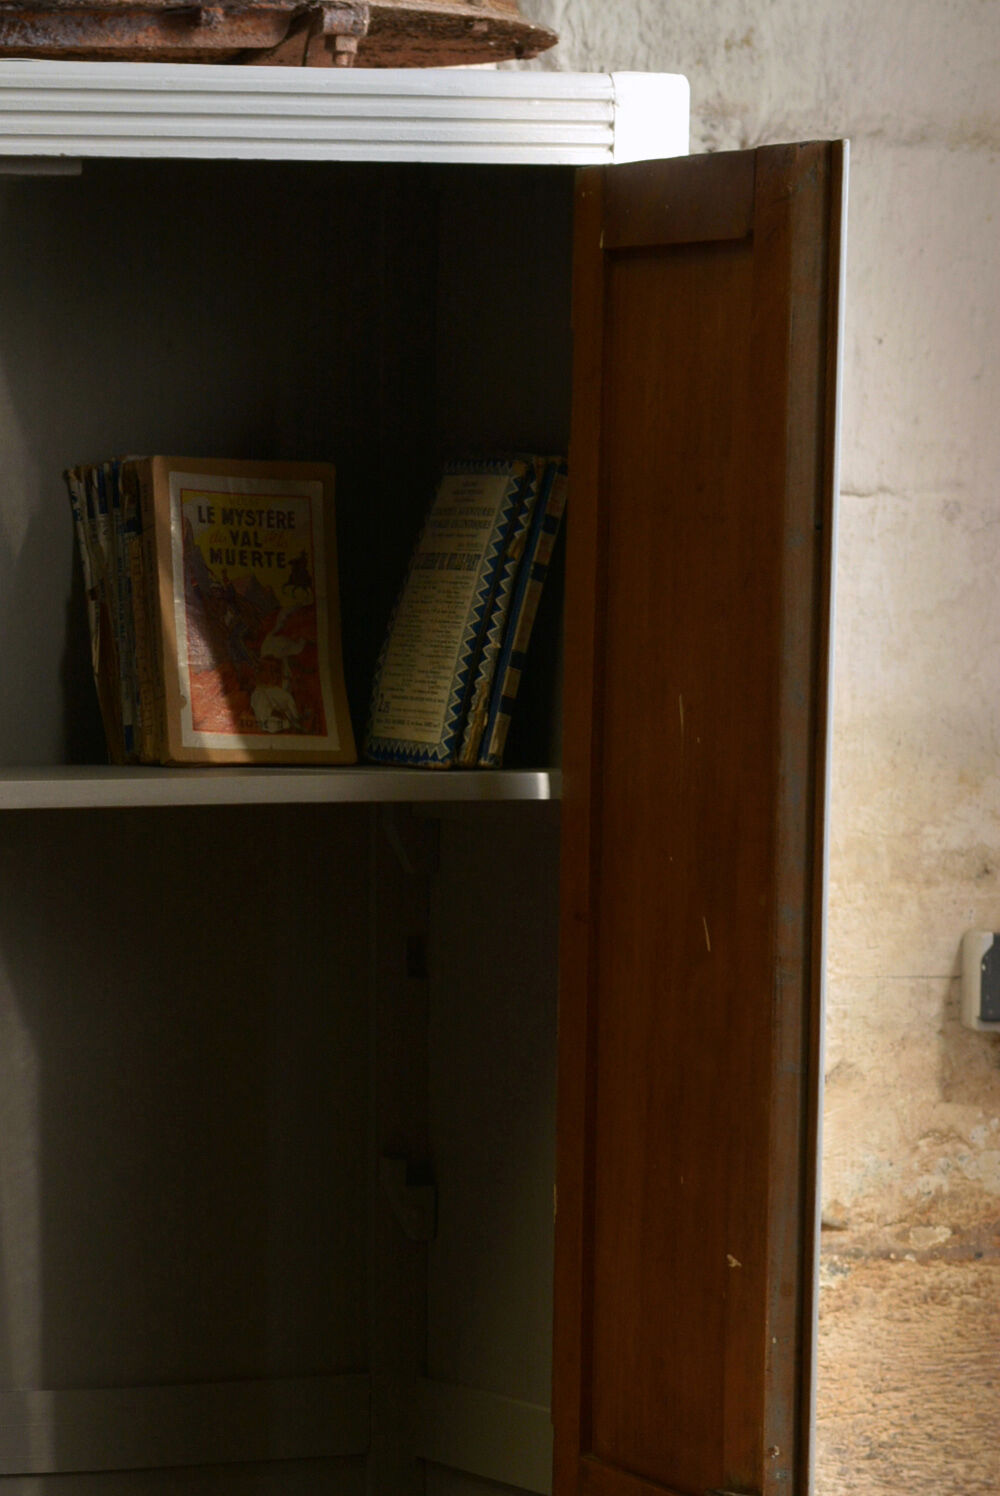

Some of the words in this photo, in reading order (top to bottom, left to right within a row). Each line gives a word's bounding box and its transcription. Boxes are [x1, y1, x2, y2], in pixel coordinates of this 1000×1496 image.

[197, 505, 216, 524] LE
[229, 529, 263, 548] VAL
[209, 548, 289, 569] MUERTE
